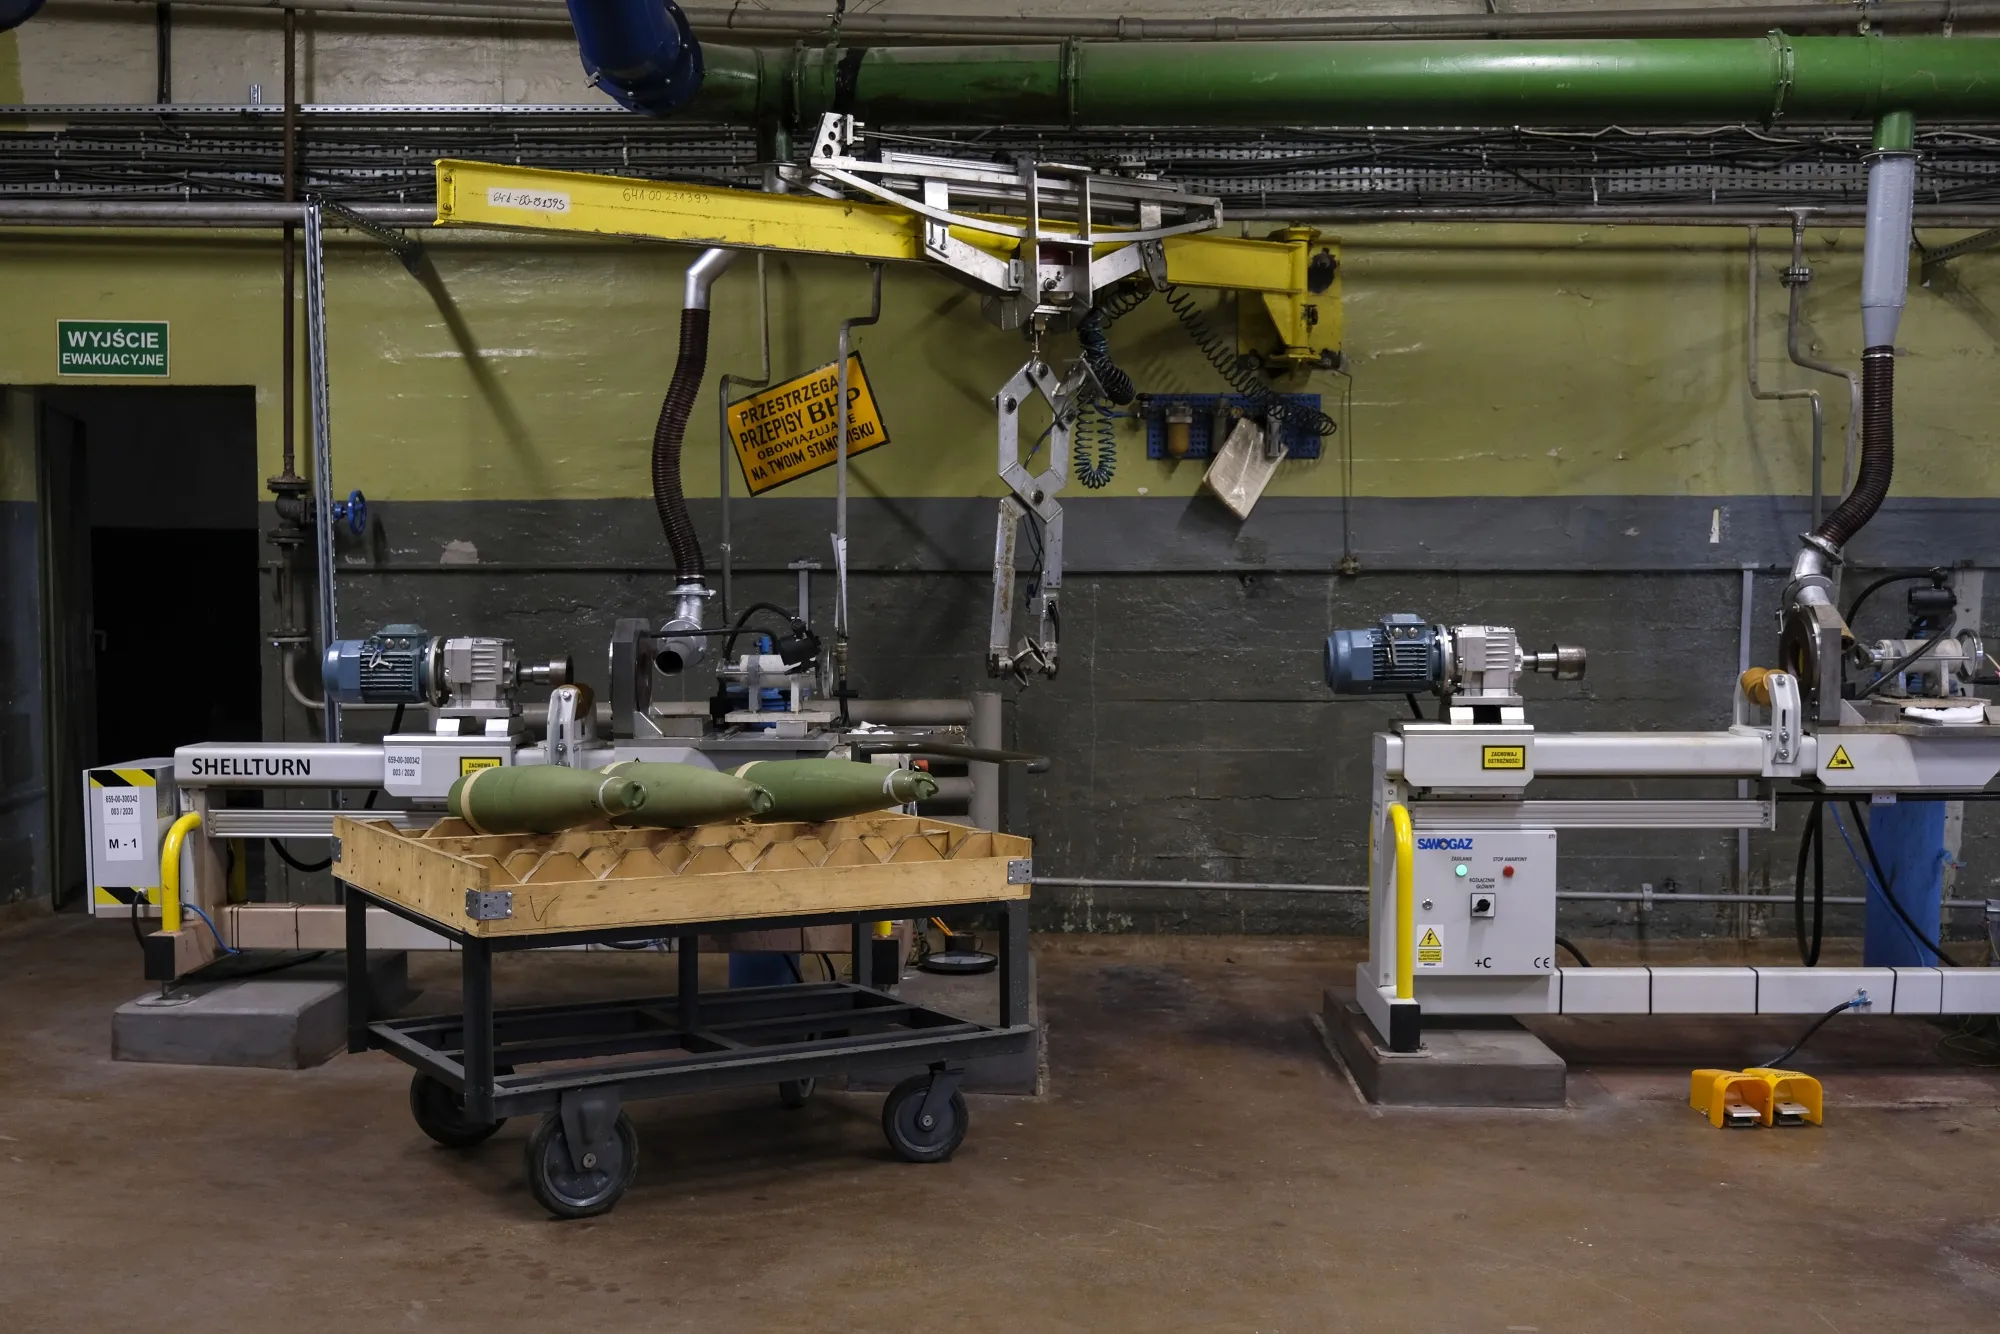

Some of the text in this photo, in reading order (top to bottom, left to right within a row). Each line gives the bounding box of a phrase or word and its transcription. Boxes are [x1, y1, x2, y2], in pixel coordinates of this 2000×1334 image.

[67, 328, 159, 349] WYJŚCIE
[62, 353, 164, 366] EWAKUACYJNE
[740, 375, 839, 427] PRZESTRZEGA
[739, 387, 861, 452] PRZEPISY BHP
[751, 466, 768, 481] NA
[768, 449, 806, 474] TWOIM
[191, 758, 311, 776] SHELLTURN
[393, 768, 401, 776] 003
[110, 807, 119, 815] 003
[122, 807, 134, 815] 2020
[109, 838, 119, 849] M
[131, 838, 137, 849] 1
